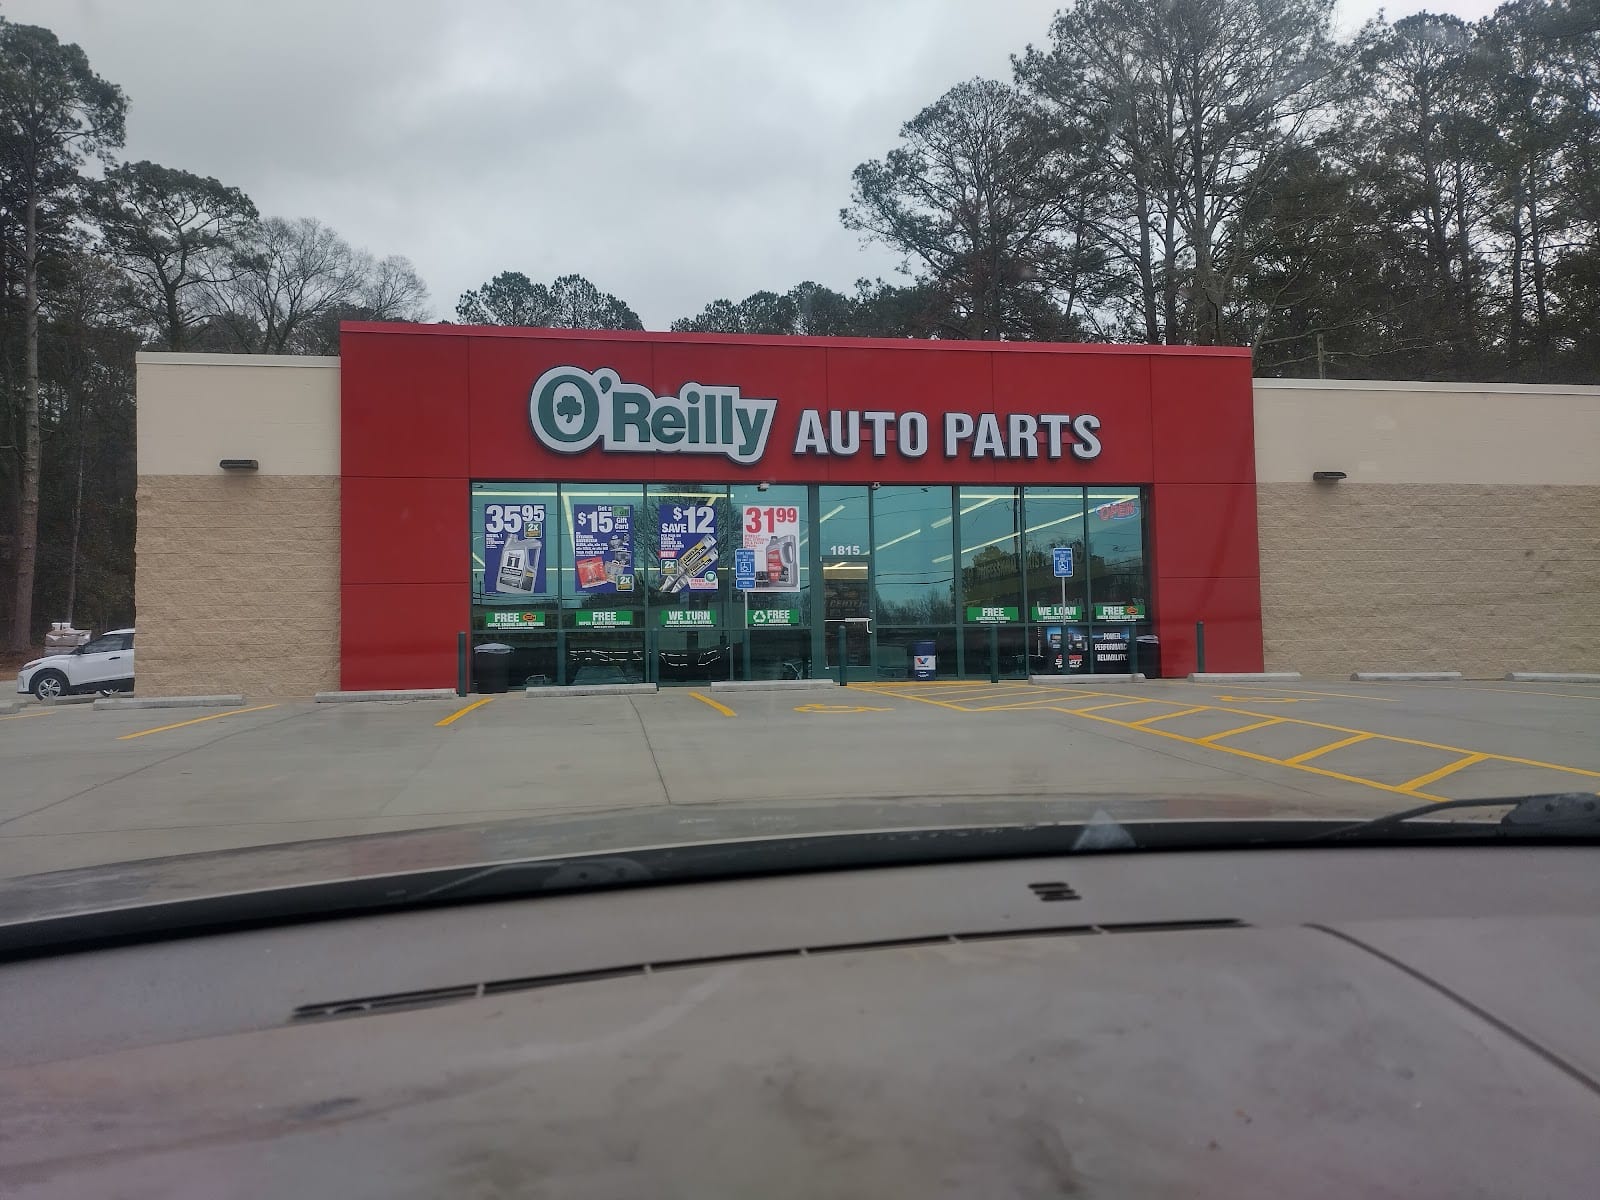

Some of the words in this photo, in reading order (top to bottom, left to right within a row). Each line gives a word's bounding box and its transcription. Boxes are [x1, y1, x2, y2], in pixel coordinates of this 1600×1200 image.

[538, 374, 768, 456] O'Reilly
[793, 409, 928, 457] AUTO
[944, 411, 1102, 458] PARTS
[1099, 502, 1135, 520] OPEN
[577, 511, 613, 533] $15
[672, 506, 715, 534] $12
[661, 523, 687, 533] SAVE
[830, 545, 860, 555] 1815
[668, 611, 683, 620] WE
[686, 611, 711, 620] TURN
[767, 610, 790, 619] FREE
[982, 607, 1004, 617] FREE
[1037, 607, 1052, 616] WE
[1054, 607, 1077, 616] LOAN
[1103, 606, 1124, 615] FREE
[494, 612, 519, 622] FREE
[592, 611, 616, 621] FREE
